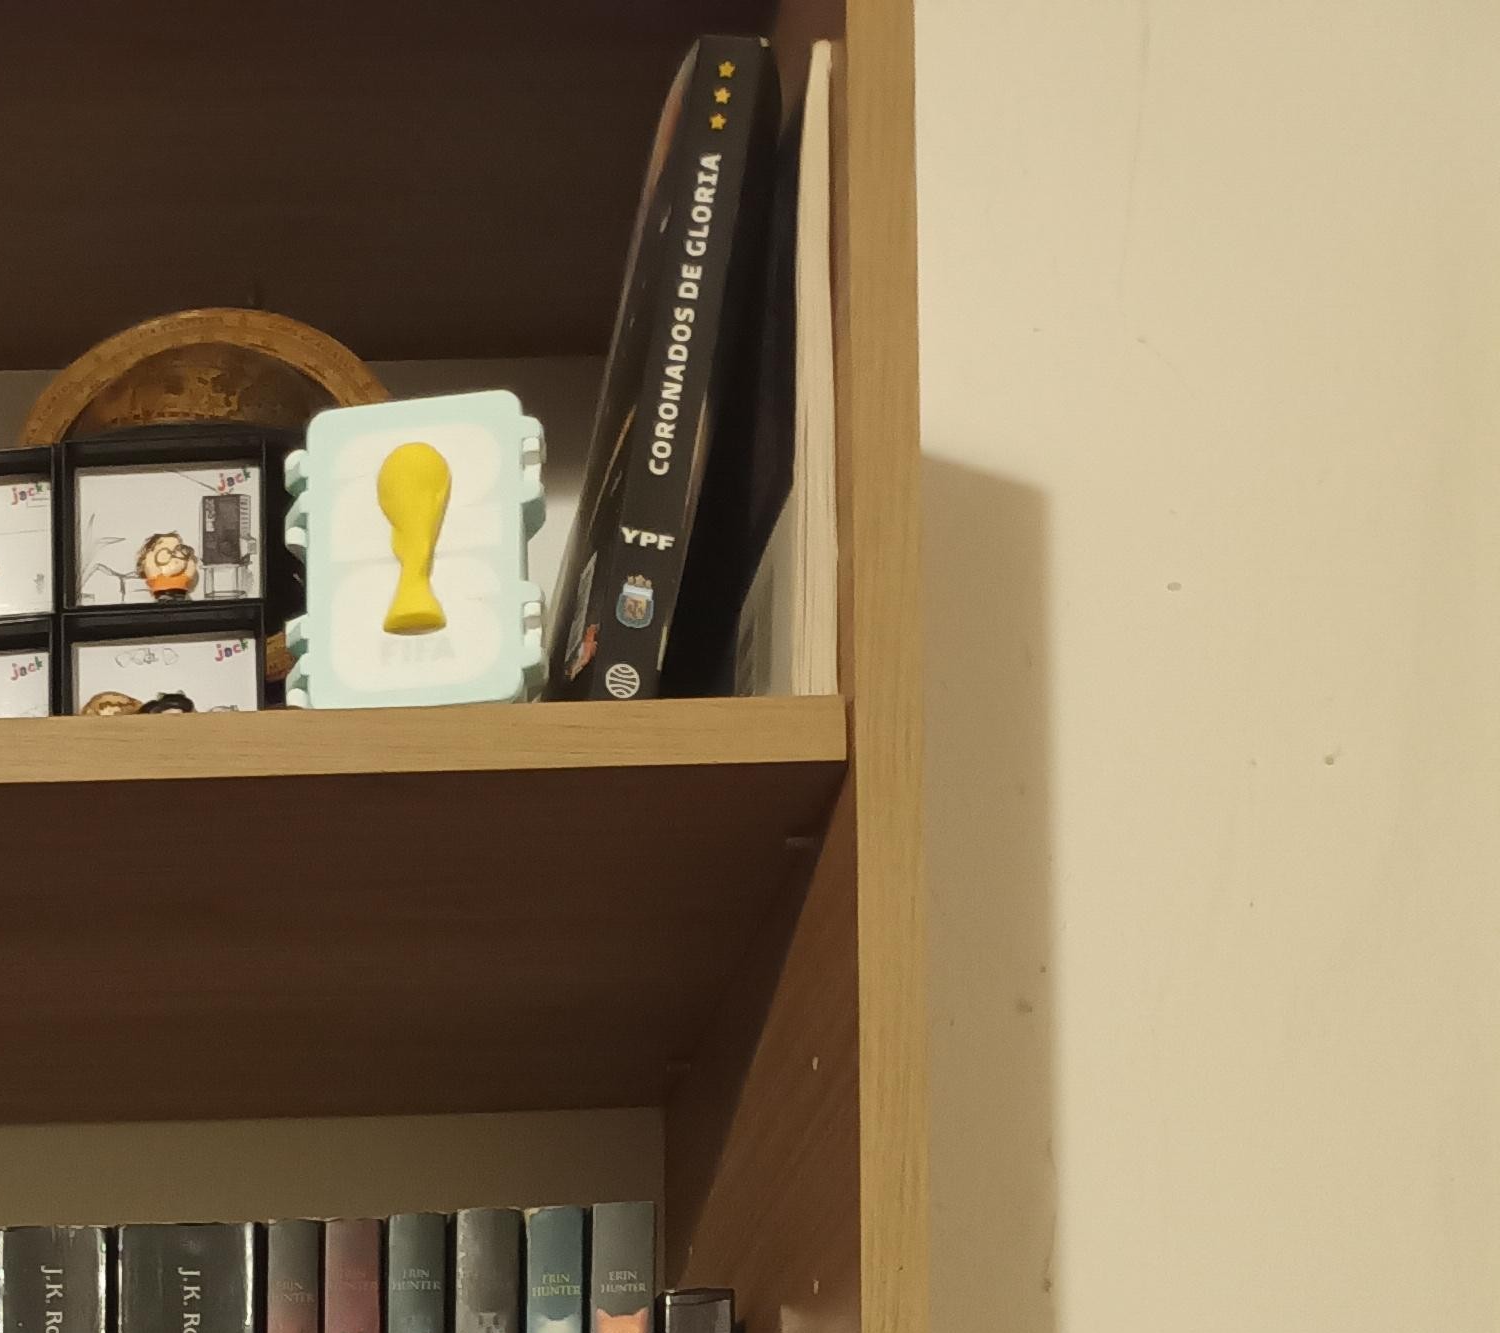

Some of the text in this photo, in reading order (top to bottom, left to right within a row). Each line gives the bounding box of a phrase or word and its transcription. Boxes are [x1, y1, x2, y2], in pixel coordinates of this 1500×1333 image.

[649, 152, 722, 477] CORONADOS DE GLORIA
[621, 527, 676, 552] YPF
